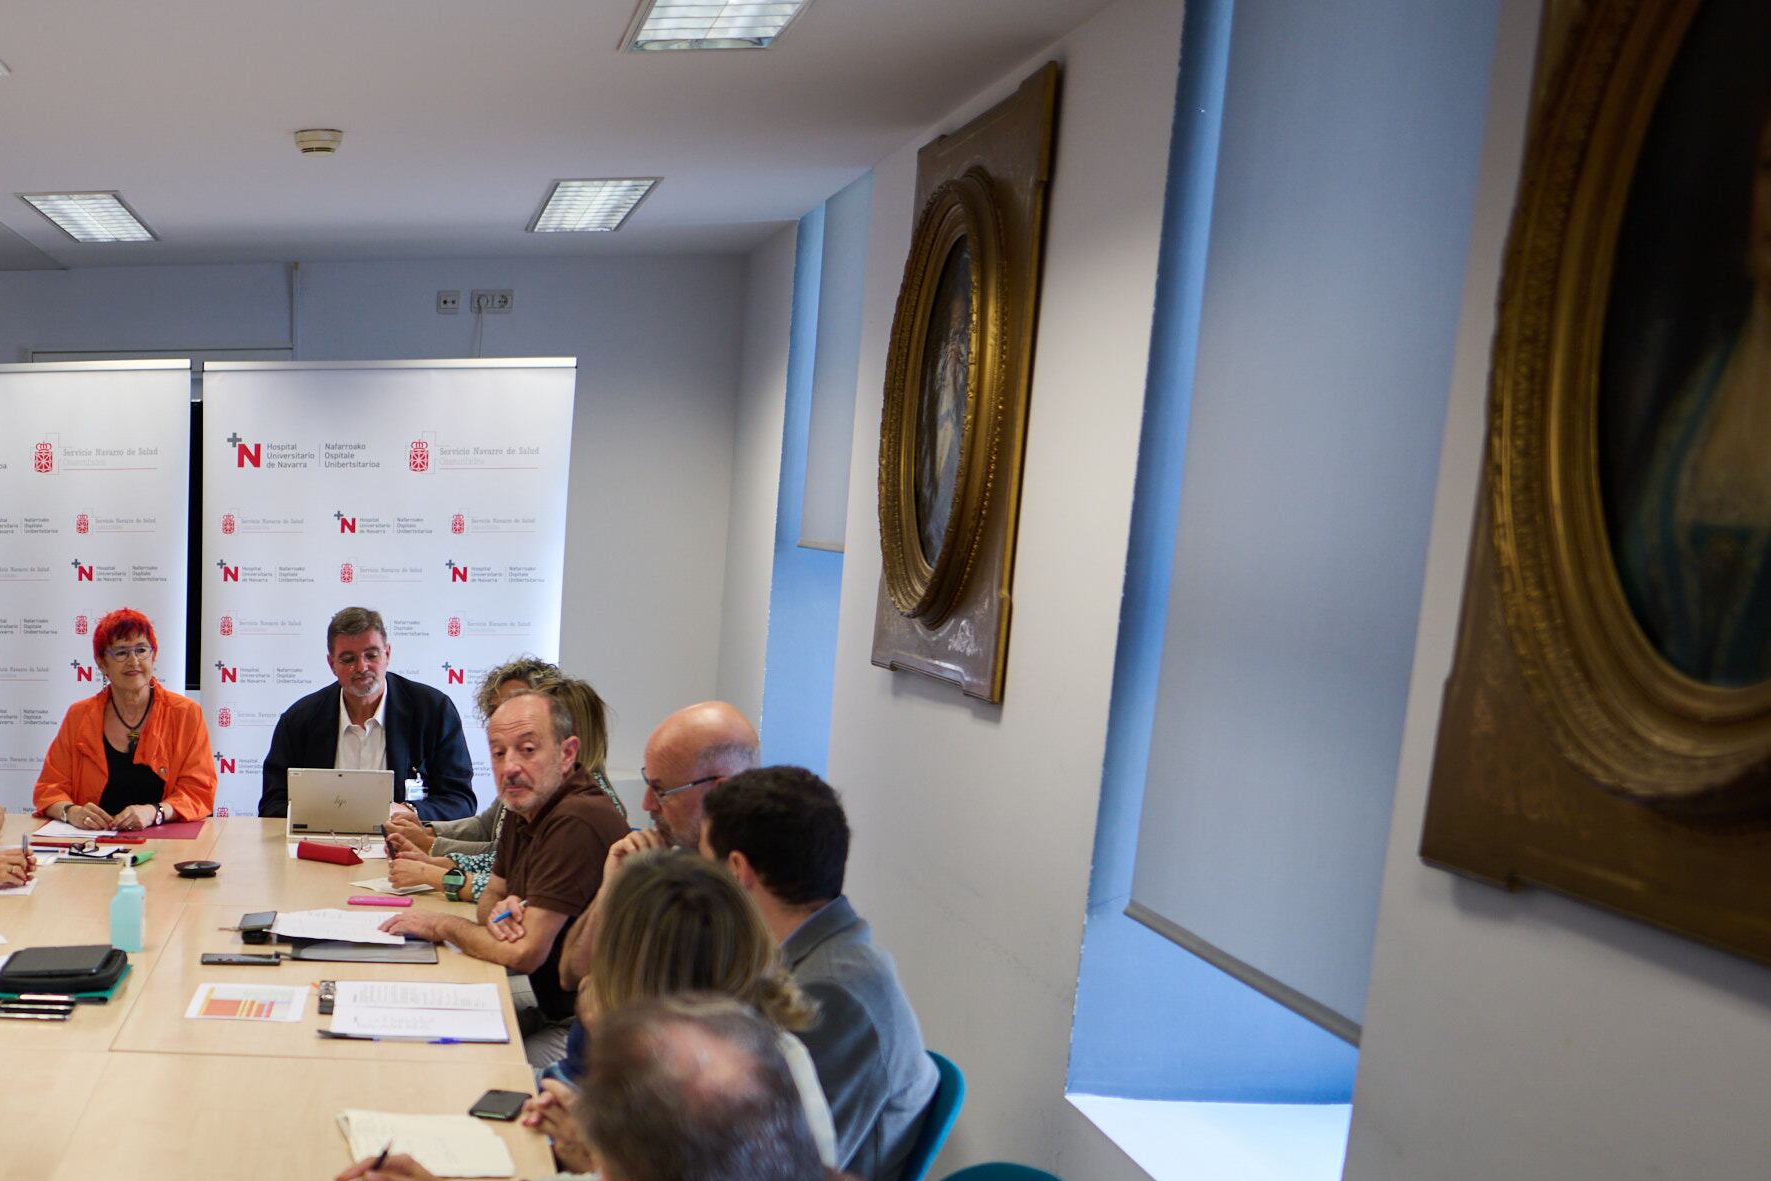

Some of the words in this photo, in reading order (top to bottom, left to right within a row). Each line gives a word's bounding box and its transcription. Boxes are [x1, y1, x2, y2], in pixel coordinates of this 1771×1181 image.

[267, 443, 297, 451] Hospital
[439, 447, 470, 455] Servicio
[474, 446, 503, 455] Navarro
[506, 446, 516, 454] de
[519, 446, 540, 455] Salud
[61, 448, 92, 456] Servicio
[138, 447, 158, 455] Salud
[267, 452, 314, 460] Universitario
[324, 452, 354, 460] Ospitale
